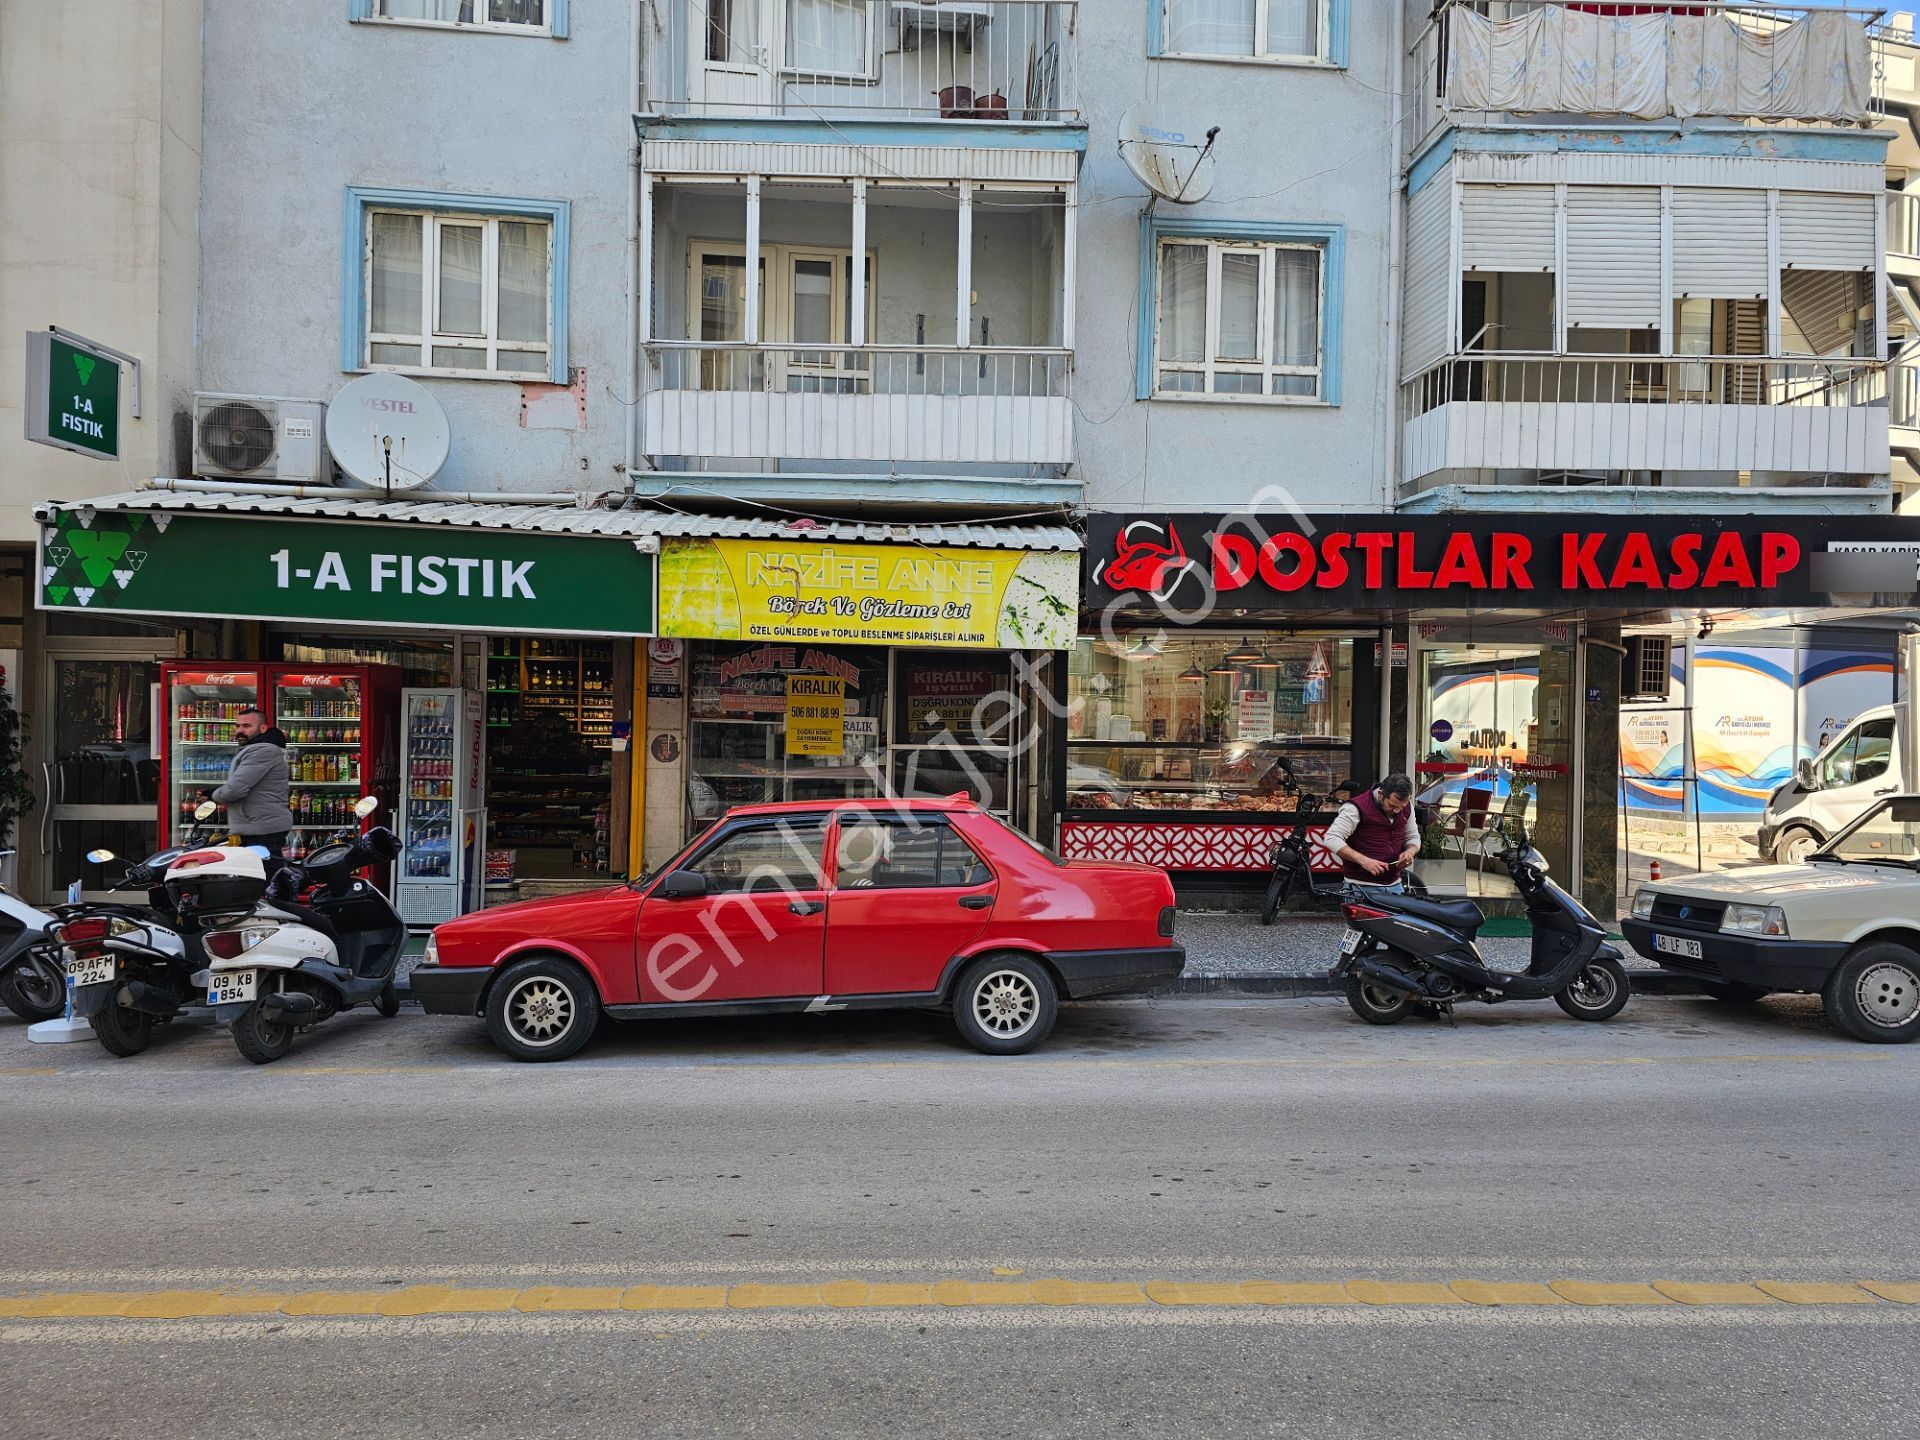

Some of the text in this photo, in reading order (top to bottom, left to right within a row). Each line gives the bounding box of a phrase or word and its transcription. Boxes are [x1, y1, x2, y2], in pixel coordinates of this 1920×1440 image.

[73, 394, 94, 414] 1-A
[61, 412, 103, 438] FISTIK
[747, 548, 994, 594] NAZİFE ANNE
[1211, 532, 1534, 591] DOSTLAR
[1561, 532, 1801, 590] KASAP
[270, 549, 536, 599] 1-A FISTIK
[768, 595, 971, 621] Börek Ve Gözleme Evi
[750, 624, 772, 635] ÖZEL
[774, 624, 819, 637] GÜNLERDE
[832, 629, 859, 638] TOPLU
[861, 629, 904, 640] BESLENME
[907, 629, 956, 642] SİPARİŞLERİ
[957, 633, 985, 642] ALINIR
[720, 643, 796, 685] NAZİFE
[800, 648, 860, 690] ANNE
[791, 706, 804, 718] 506
[806, 706, 818, 718] 881
[820, 707, 830, 718] 88
[830, 707, 840, 718] 99
[1658, 936, 1700, 957] 48 LF 183
[68, 957, 113, 974] 09 AFM
[82, 971, 106, 984] 224
[213, 973, 253, 989] 09 KB
[220, 988, 243, 1000] 854
